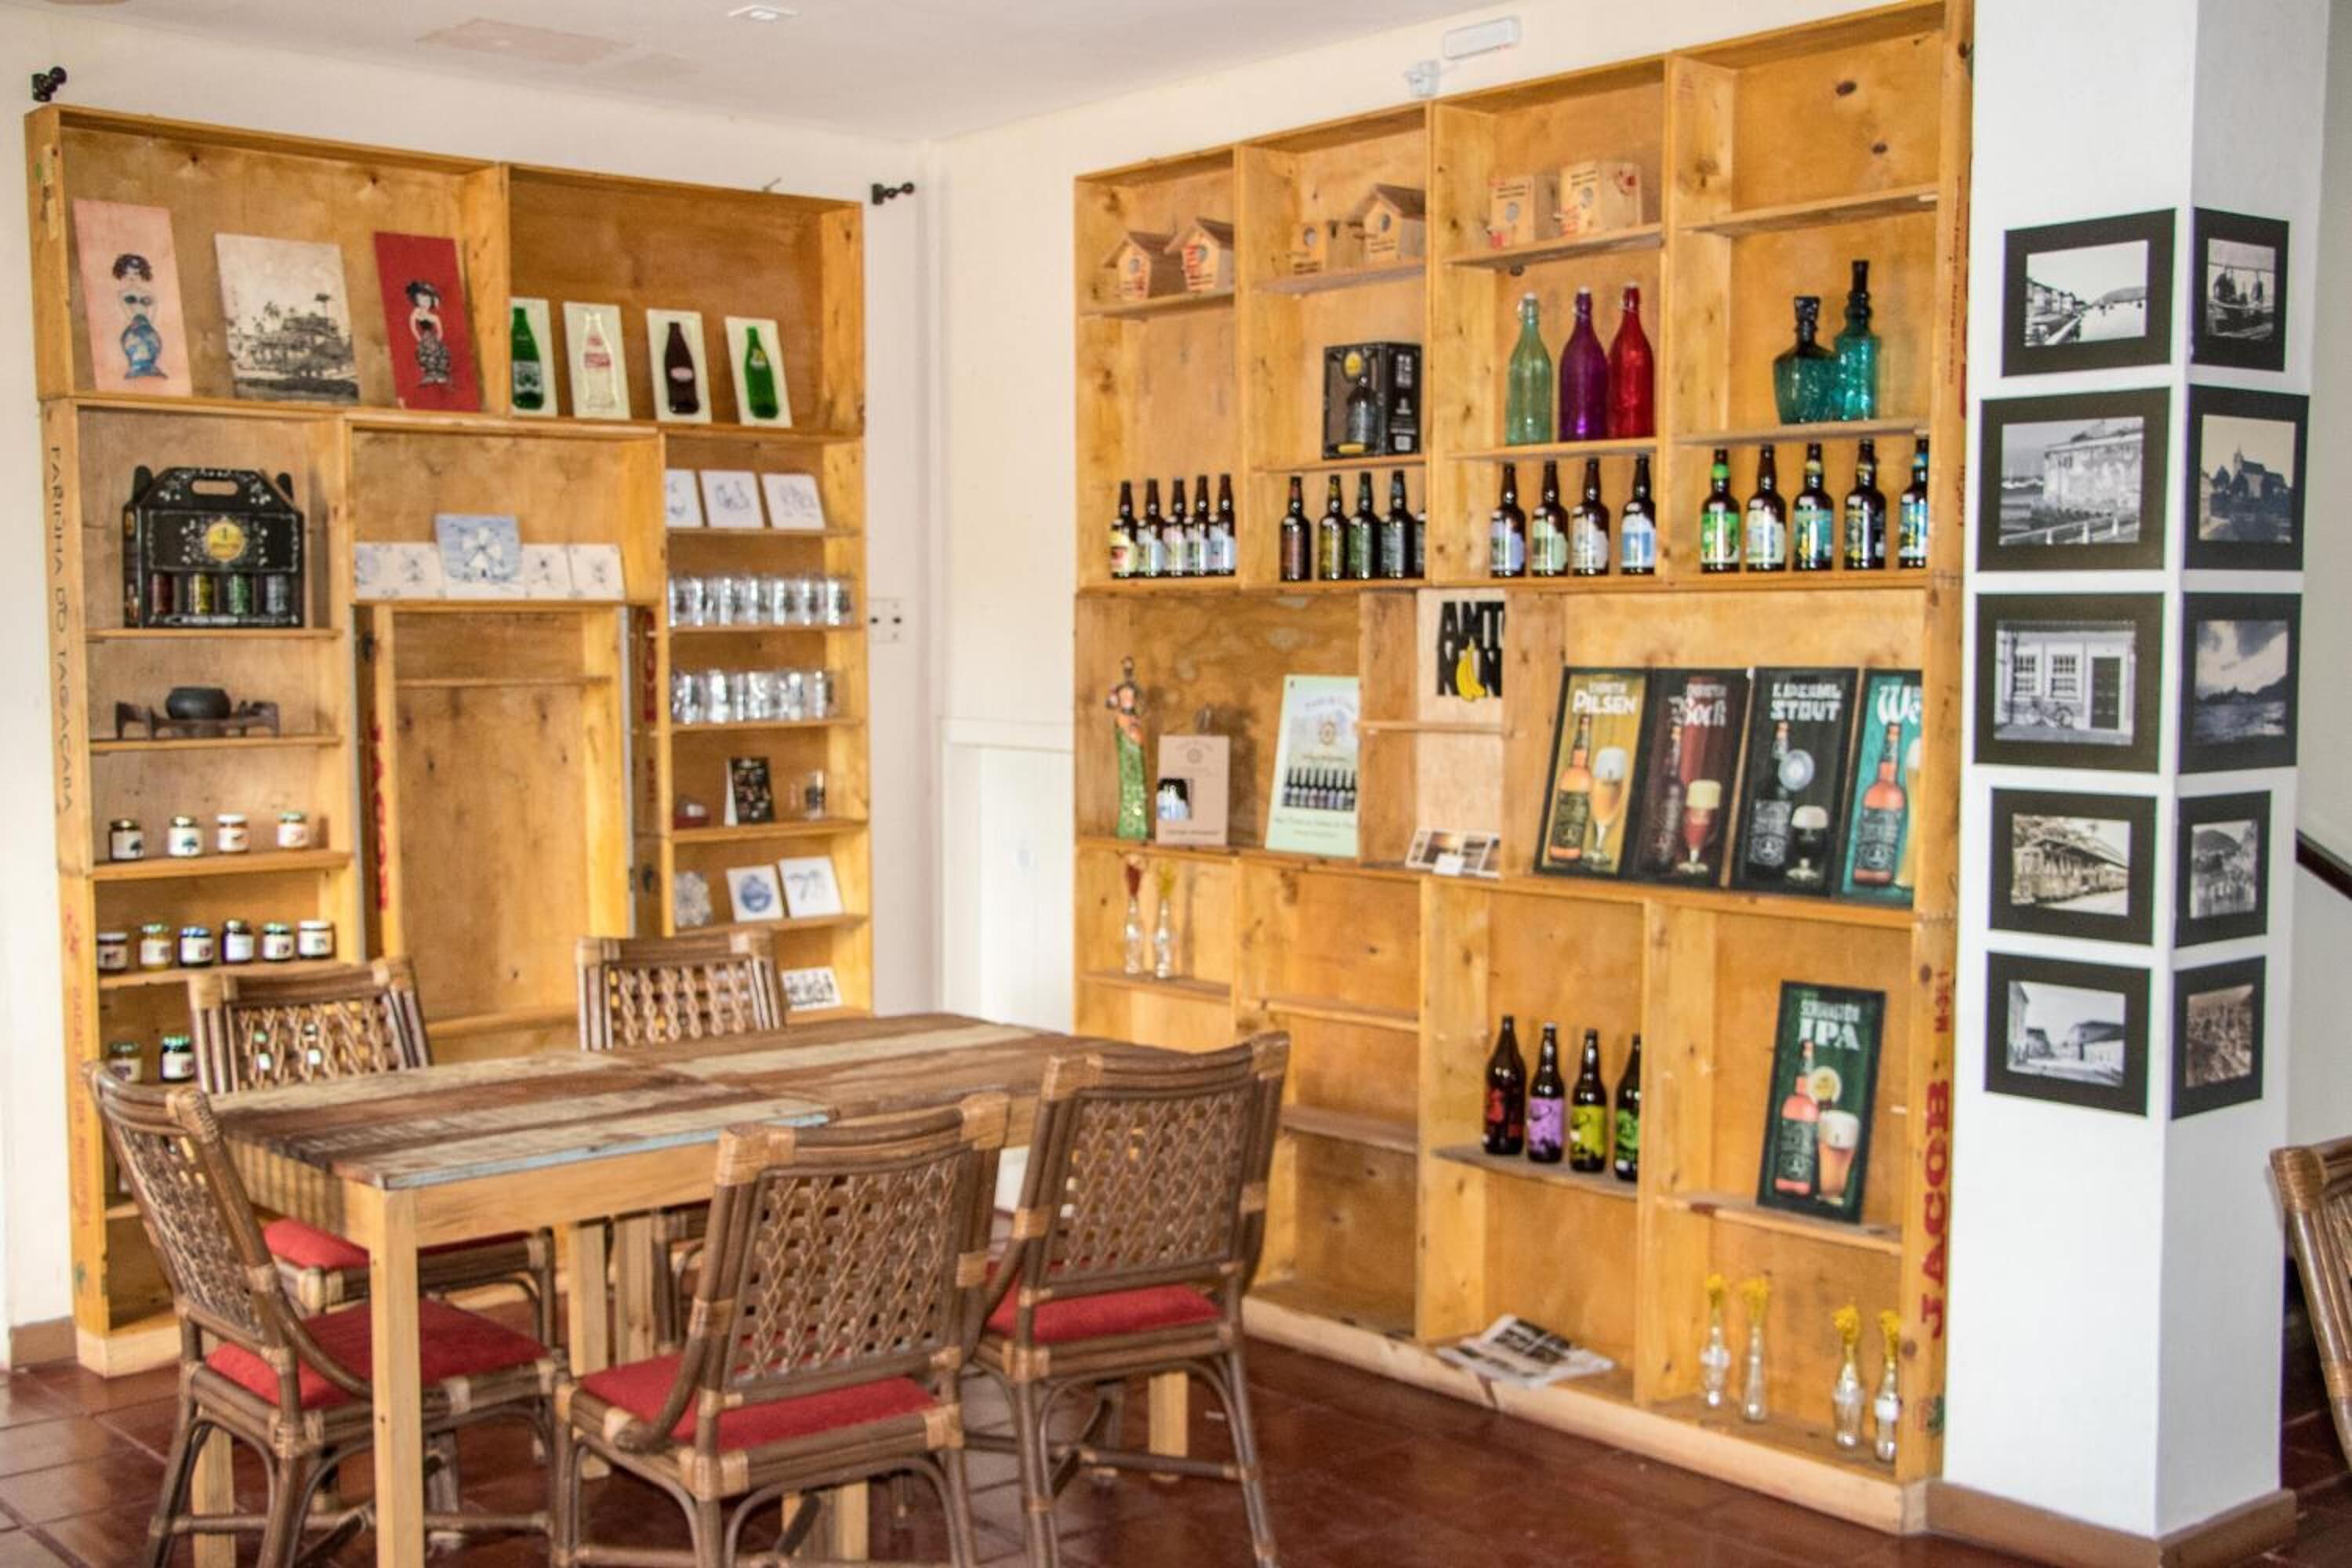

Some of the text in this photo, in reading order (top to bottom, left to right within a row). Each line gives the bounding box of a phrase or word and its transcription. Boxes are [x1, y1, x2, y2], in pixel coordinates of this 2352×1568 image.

[51, 447, 64, 575] FARINHA
[1573, 690, 1637, 715] PILSEN
[1769, 699, 1841, 721] STOUT
[1798, 1016, 1860, 1051] IPA
[1921, 1080, 1949, 1339] JACOB
